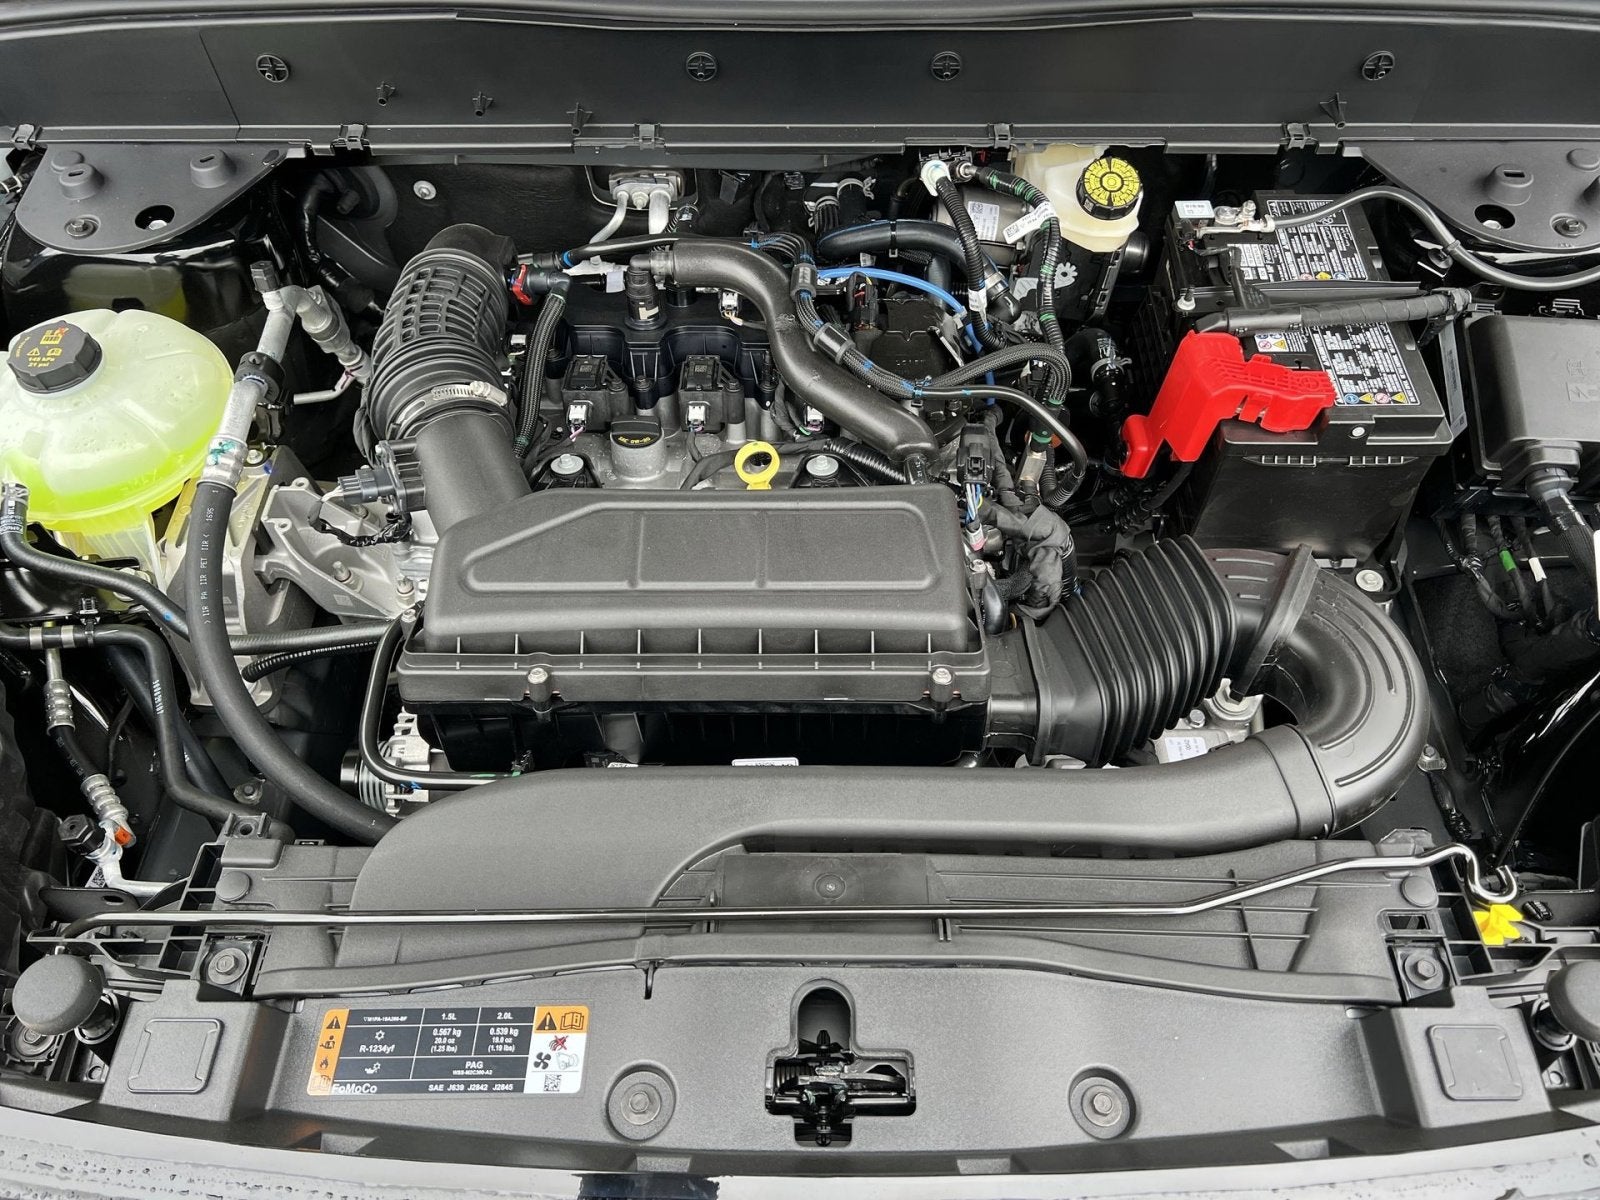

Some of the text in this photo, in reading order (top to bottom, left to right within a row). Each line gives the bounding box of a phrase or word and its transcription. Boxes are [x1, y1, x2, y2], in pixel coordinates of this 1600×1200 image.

[441, 1012, 457, 1021] 1.5L
[496, 1011, 514, 1020] 2.0L
[432, 1027, 462, 1038] 0.567 kg
[489, 1027, 520, 1037] 0.539 kg
[359, 1044, 396, 1055] R-1234yf
[465, 1060, 484, 1069] PAG
[331, 1082, 378, 1094] FoMoCo
[428, 1083, 514, 1092] SAE J639 J2842 J2845
